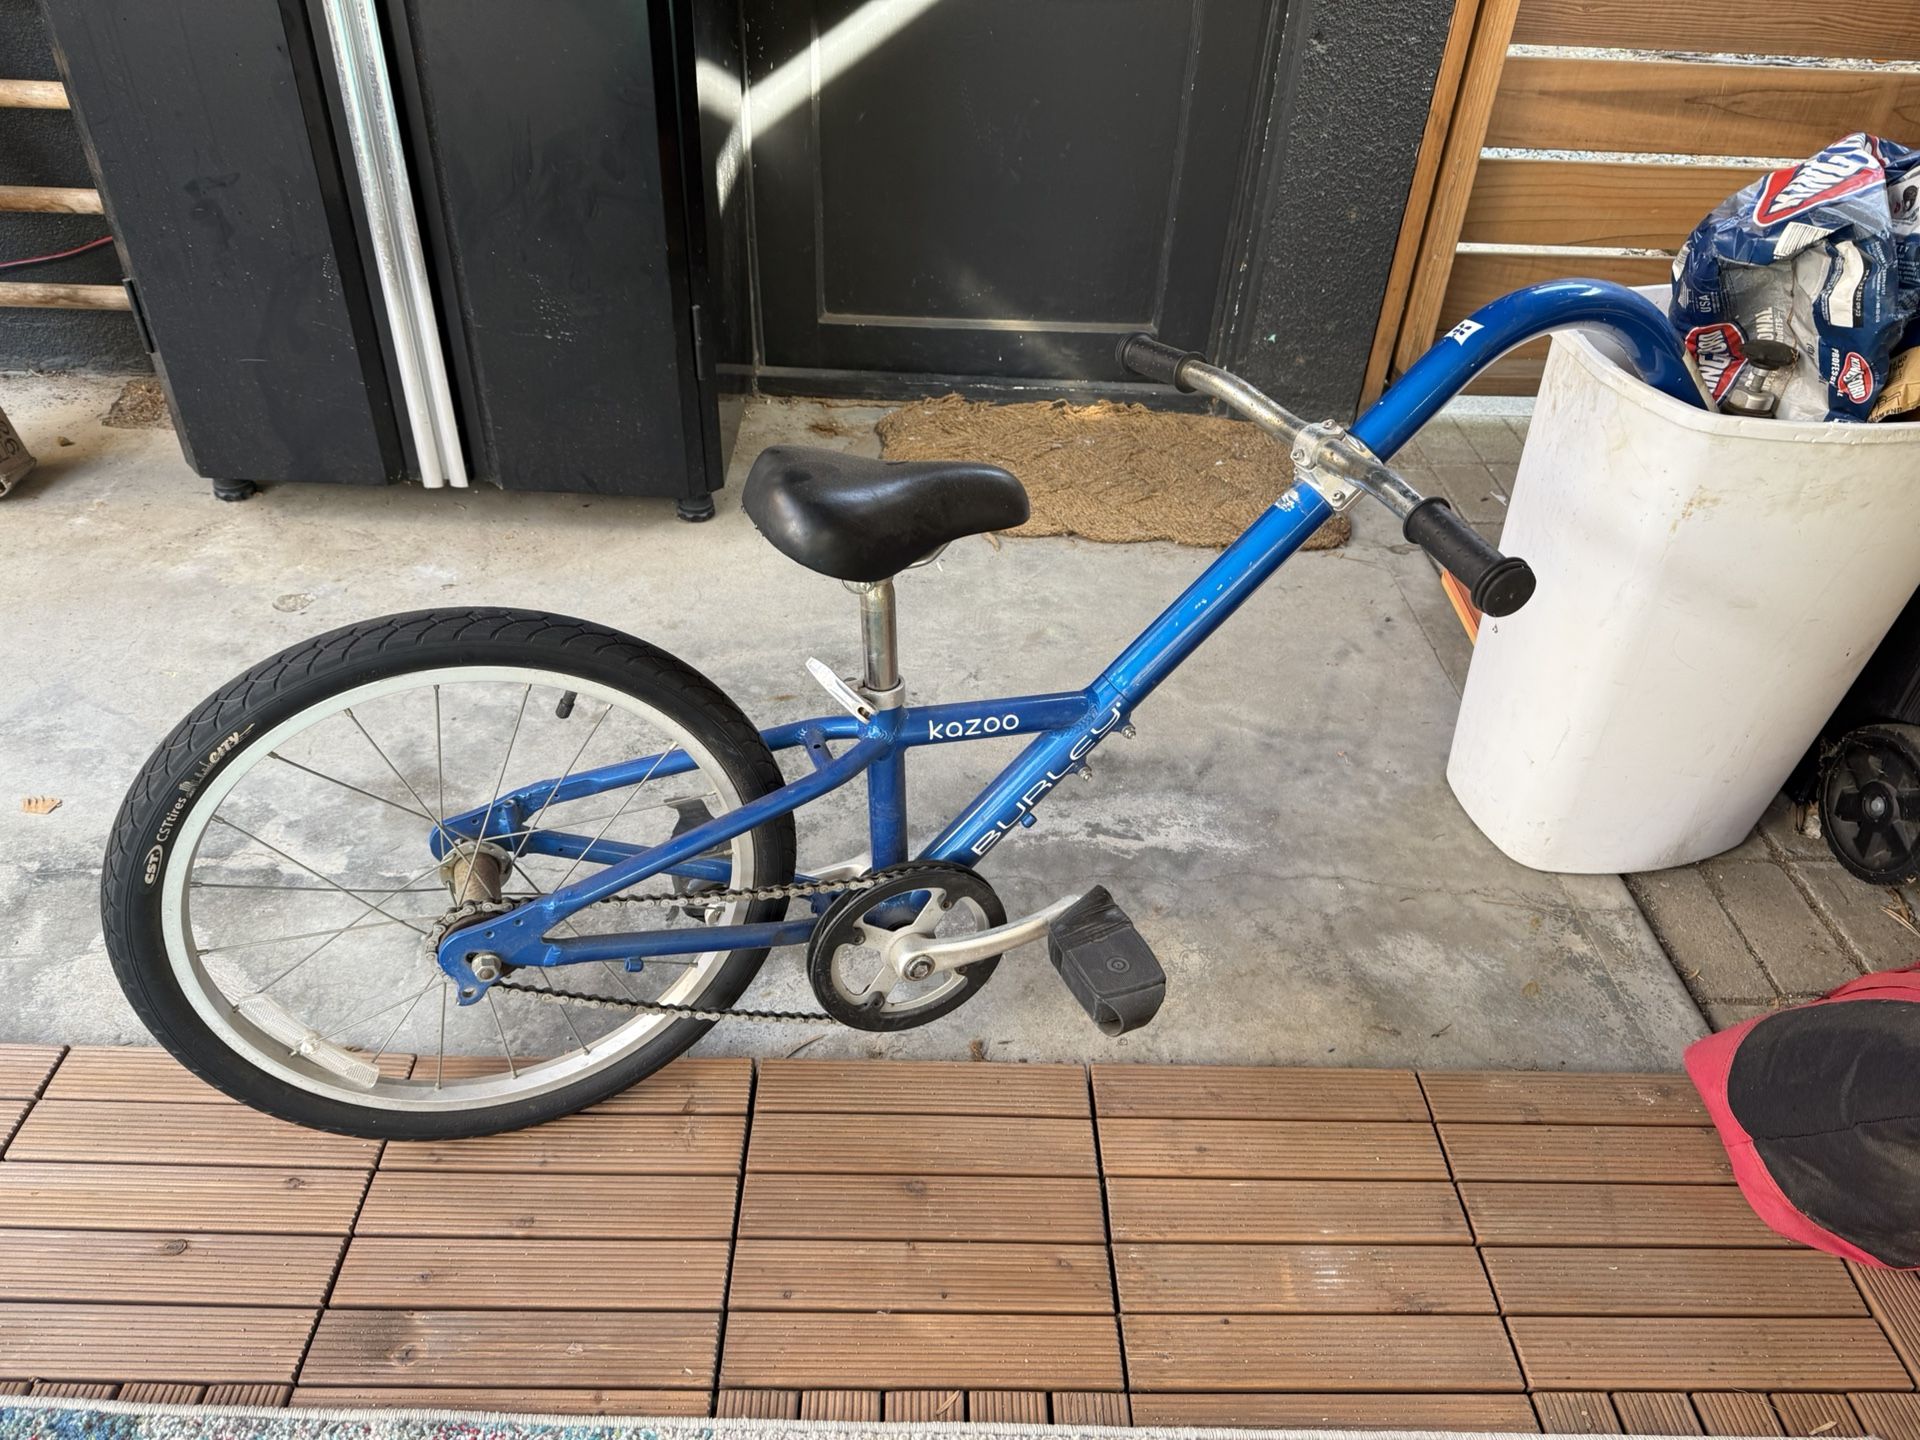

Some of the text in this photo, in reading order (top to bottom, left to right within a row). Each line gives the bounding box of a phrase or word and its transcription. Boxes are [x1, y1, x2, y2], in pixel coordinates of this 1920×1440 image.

[1699, 295, 1712, 313] USA
[929, 714, 1020, 740] kazoo
[971, 707, 1120, 856] BURLEY
